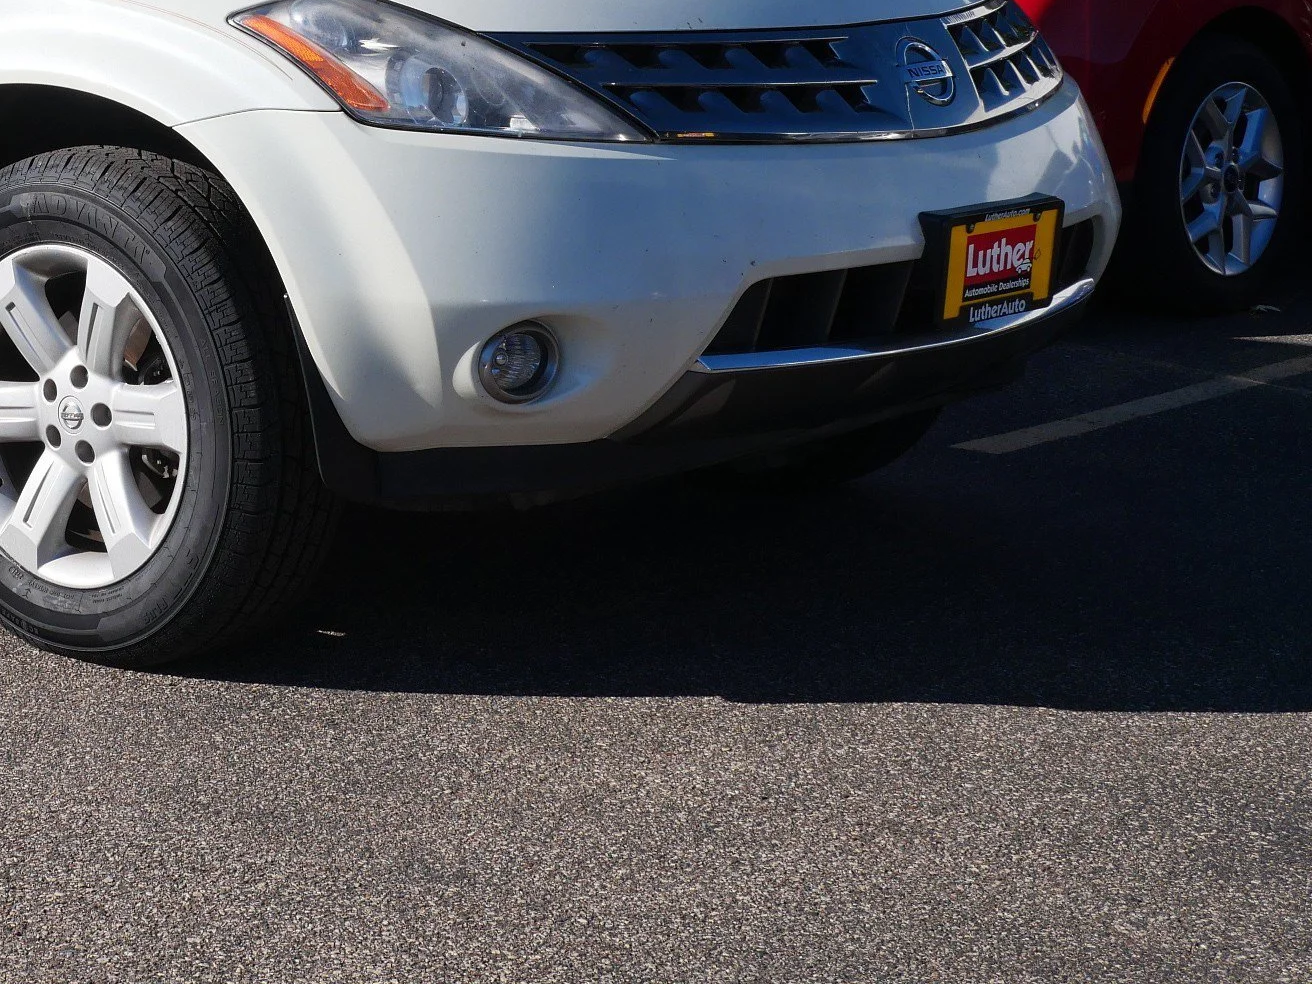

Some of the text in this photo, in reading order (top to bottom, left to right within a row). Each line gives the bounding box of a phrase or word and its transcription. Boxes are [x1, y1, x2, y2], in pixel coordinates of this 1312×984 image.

[907, 65, 947, 78] NISSA
[984, 208, 1031, 222] LutherAuto.com
[966, 237, 1035, 277] Luther
[964, 277, 1030, 297] Automobile Dealerships
[969, 298, 1027, 322] LutherAuto
